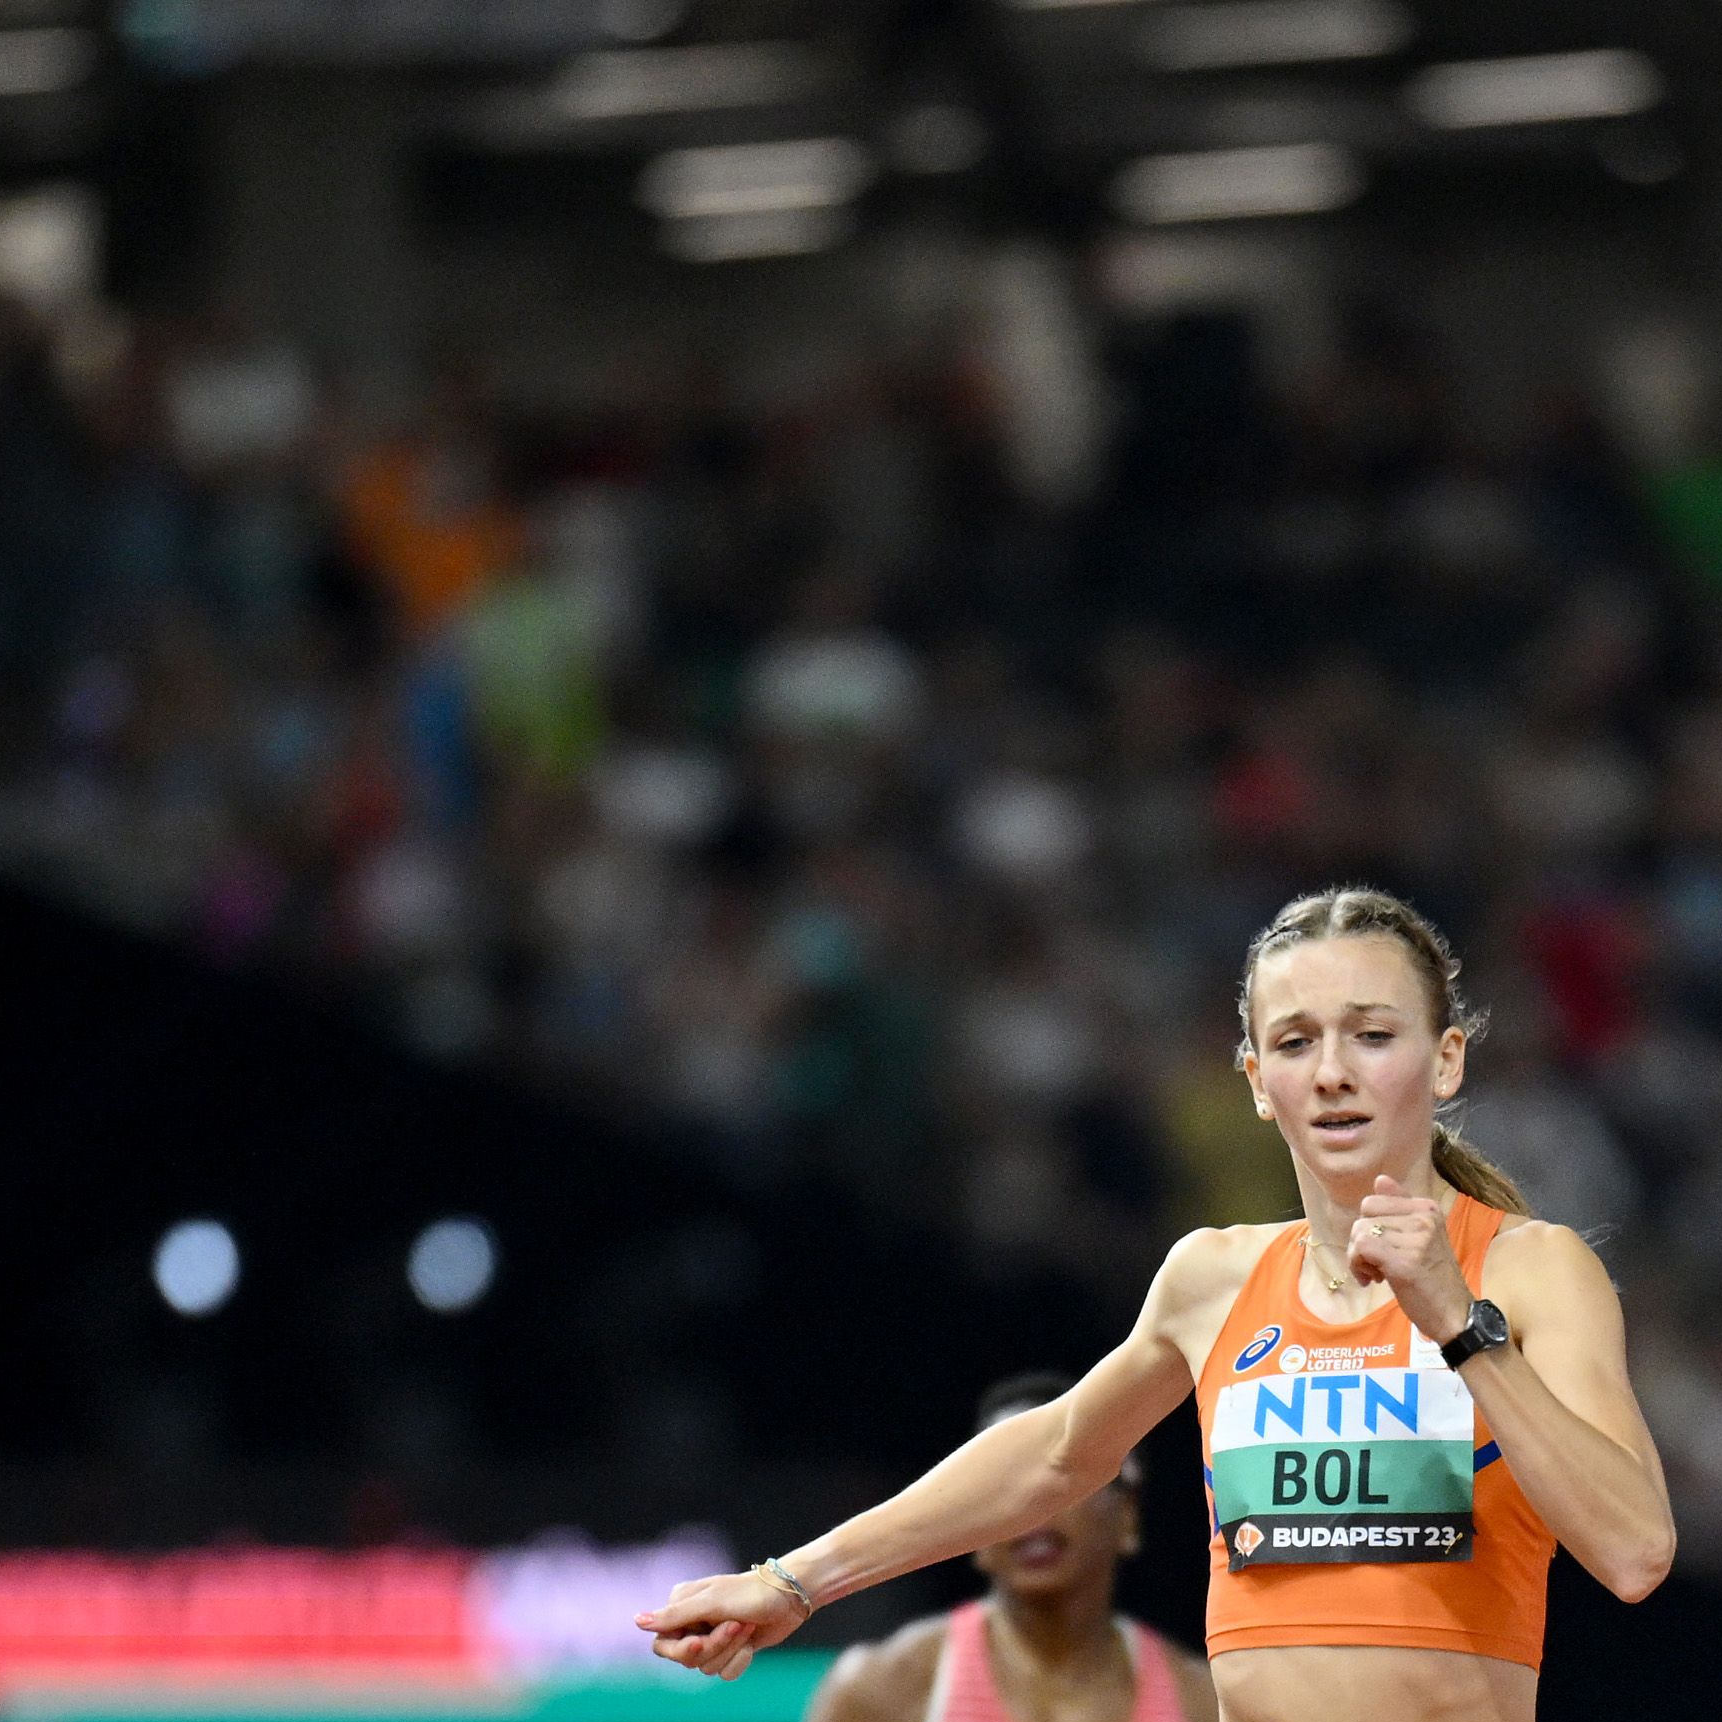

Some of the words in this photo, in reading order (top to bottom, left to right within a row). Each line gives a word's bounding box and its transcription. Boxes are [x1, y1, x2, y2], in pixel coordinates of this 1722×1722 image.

[1307, 1344, 1396, 1360] NEDERLANDSE
[1306, 1357, 1365, 1371] LOTERIJ
[1252, 1372, 1420, 1438] NTN
[1270, 1448, 1390, 1507] BOL
[1271, 1526, 1420, 1548] BUDAPEST
[1423, 1526, 1457, 1548] 23
